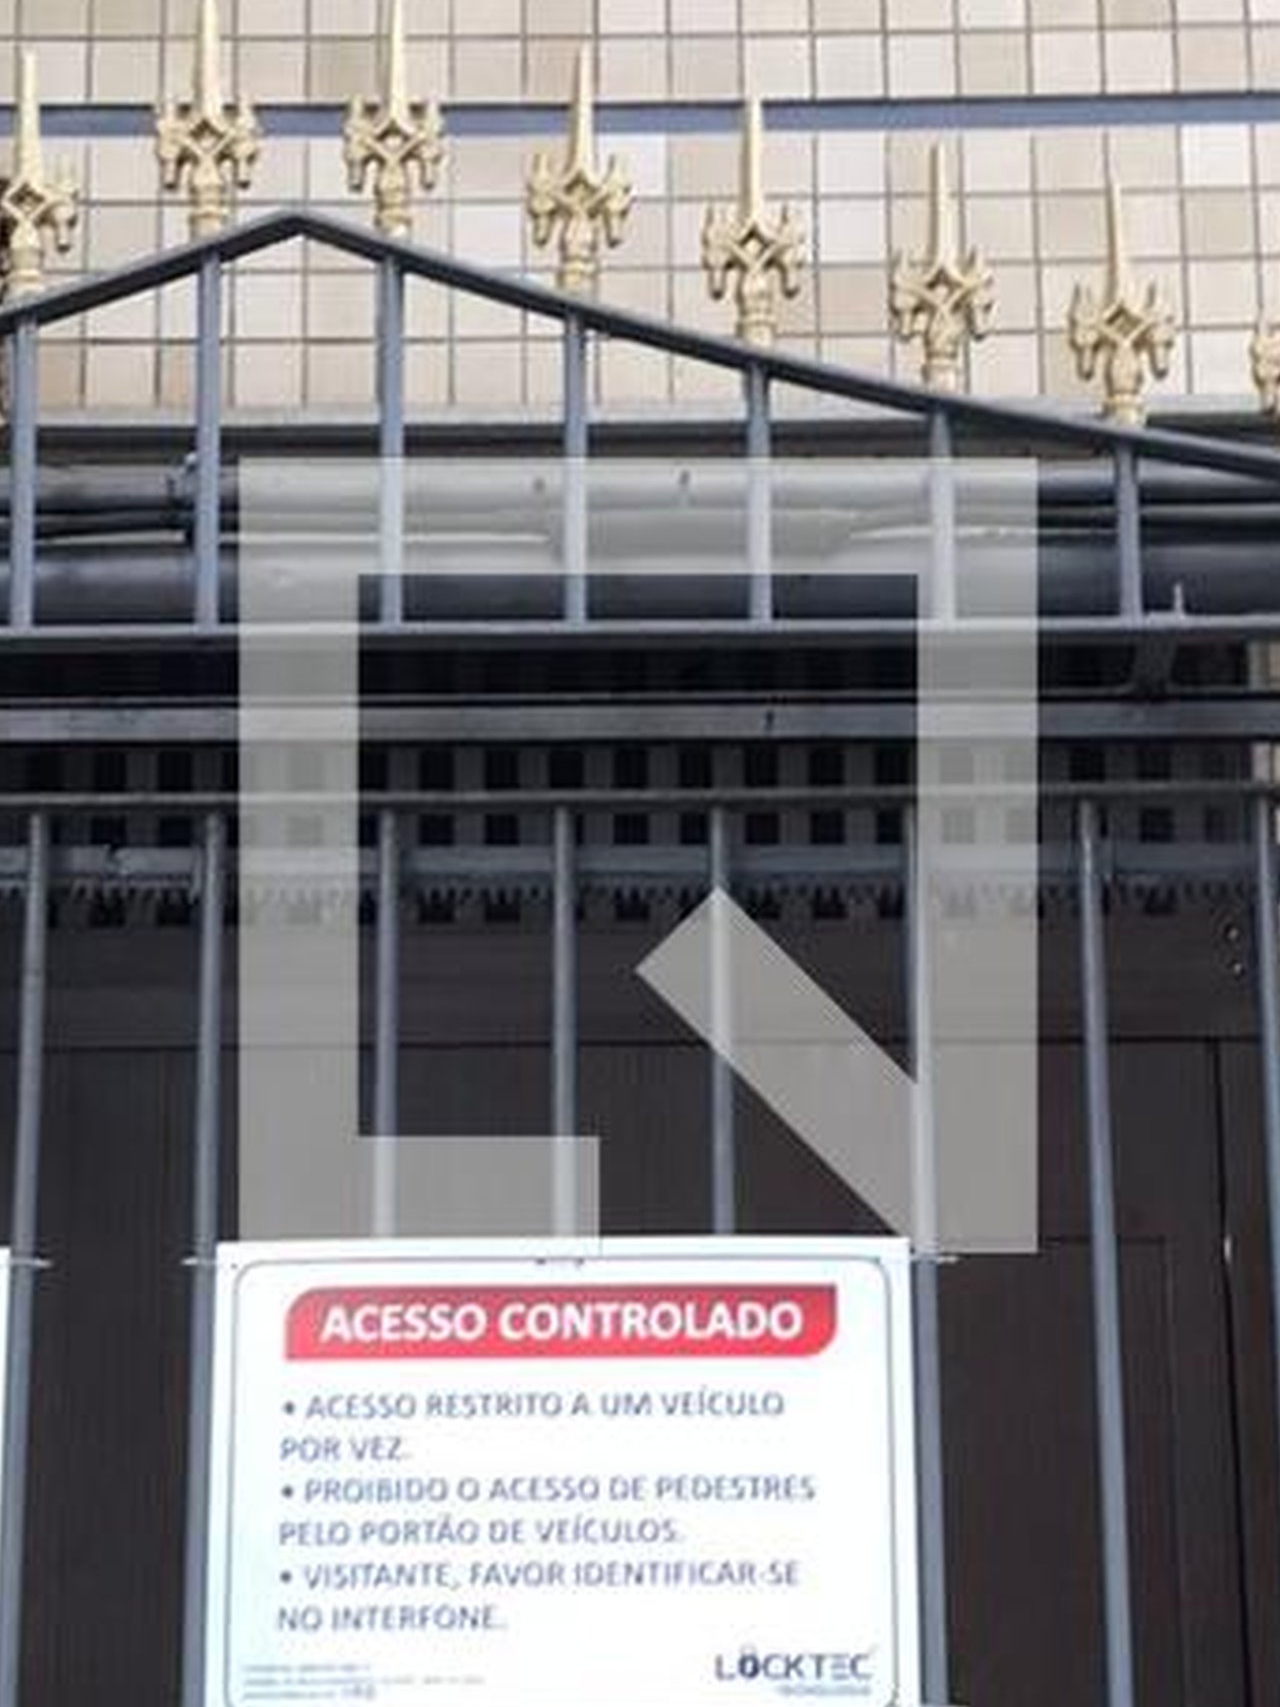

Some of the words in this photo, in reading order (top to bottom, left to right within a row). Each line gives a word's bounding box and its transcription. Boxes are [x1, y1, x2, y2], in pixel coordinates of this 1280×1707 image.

[321, 1304, 486, 1343] ACESSO
[499, 1302, 804, 1338] CONTROLADO
[306, 1393, 416, 1419] ACESSO
[425, 1392, 562, 1418] RESTRITO
[572, 1393, 594, 1416] A
[601, 1392, 652, 1416] UM
[658, 1386, 785, 1416] VEÍCULO
[281, 1438, 341, 1463] POR
[350, 1438, 411, 1462] VEZ.
[306, 1478, 448, 1504] PROIBIDO
[457, 1478, 480, 1502] O
[489, 1478, 599, 1502] ACESSO
[609, 1477, 646, 1501] DE
[656, 1475, 816, 1502] PEDESTRES
[280, 1521, 351, 1546] PELO
[361, 1516, 479, 1545] PORTÃO
[490, 1520, 524, 1543] DE
[532, 1514, 682, 1543] VEÍCULOS.
[304, 1563, 459, 1592] VISITANTE,
[470, 1562, 565, 1587] FAVOR
[575, 1560, 799, 1586] IDENTIFICAR-SE
[279, 1606, 324, 1632] NO
[333, 1605, 507, 1631] INTERFONE.
